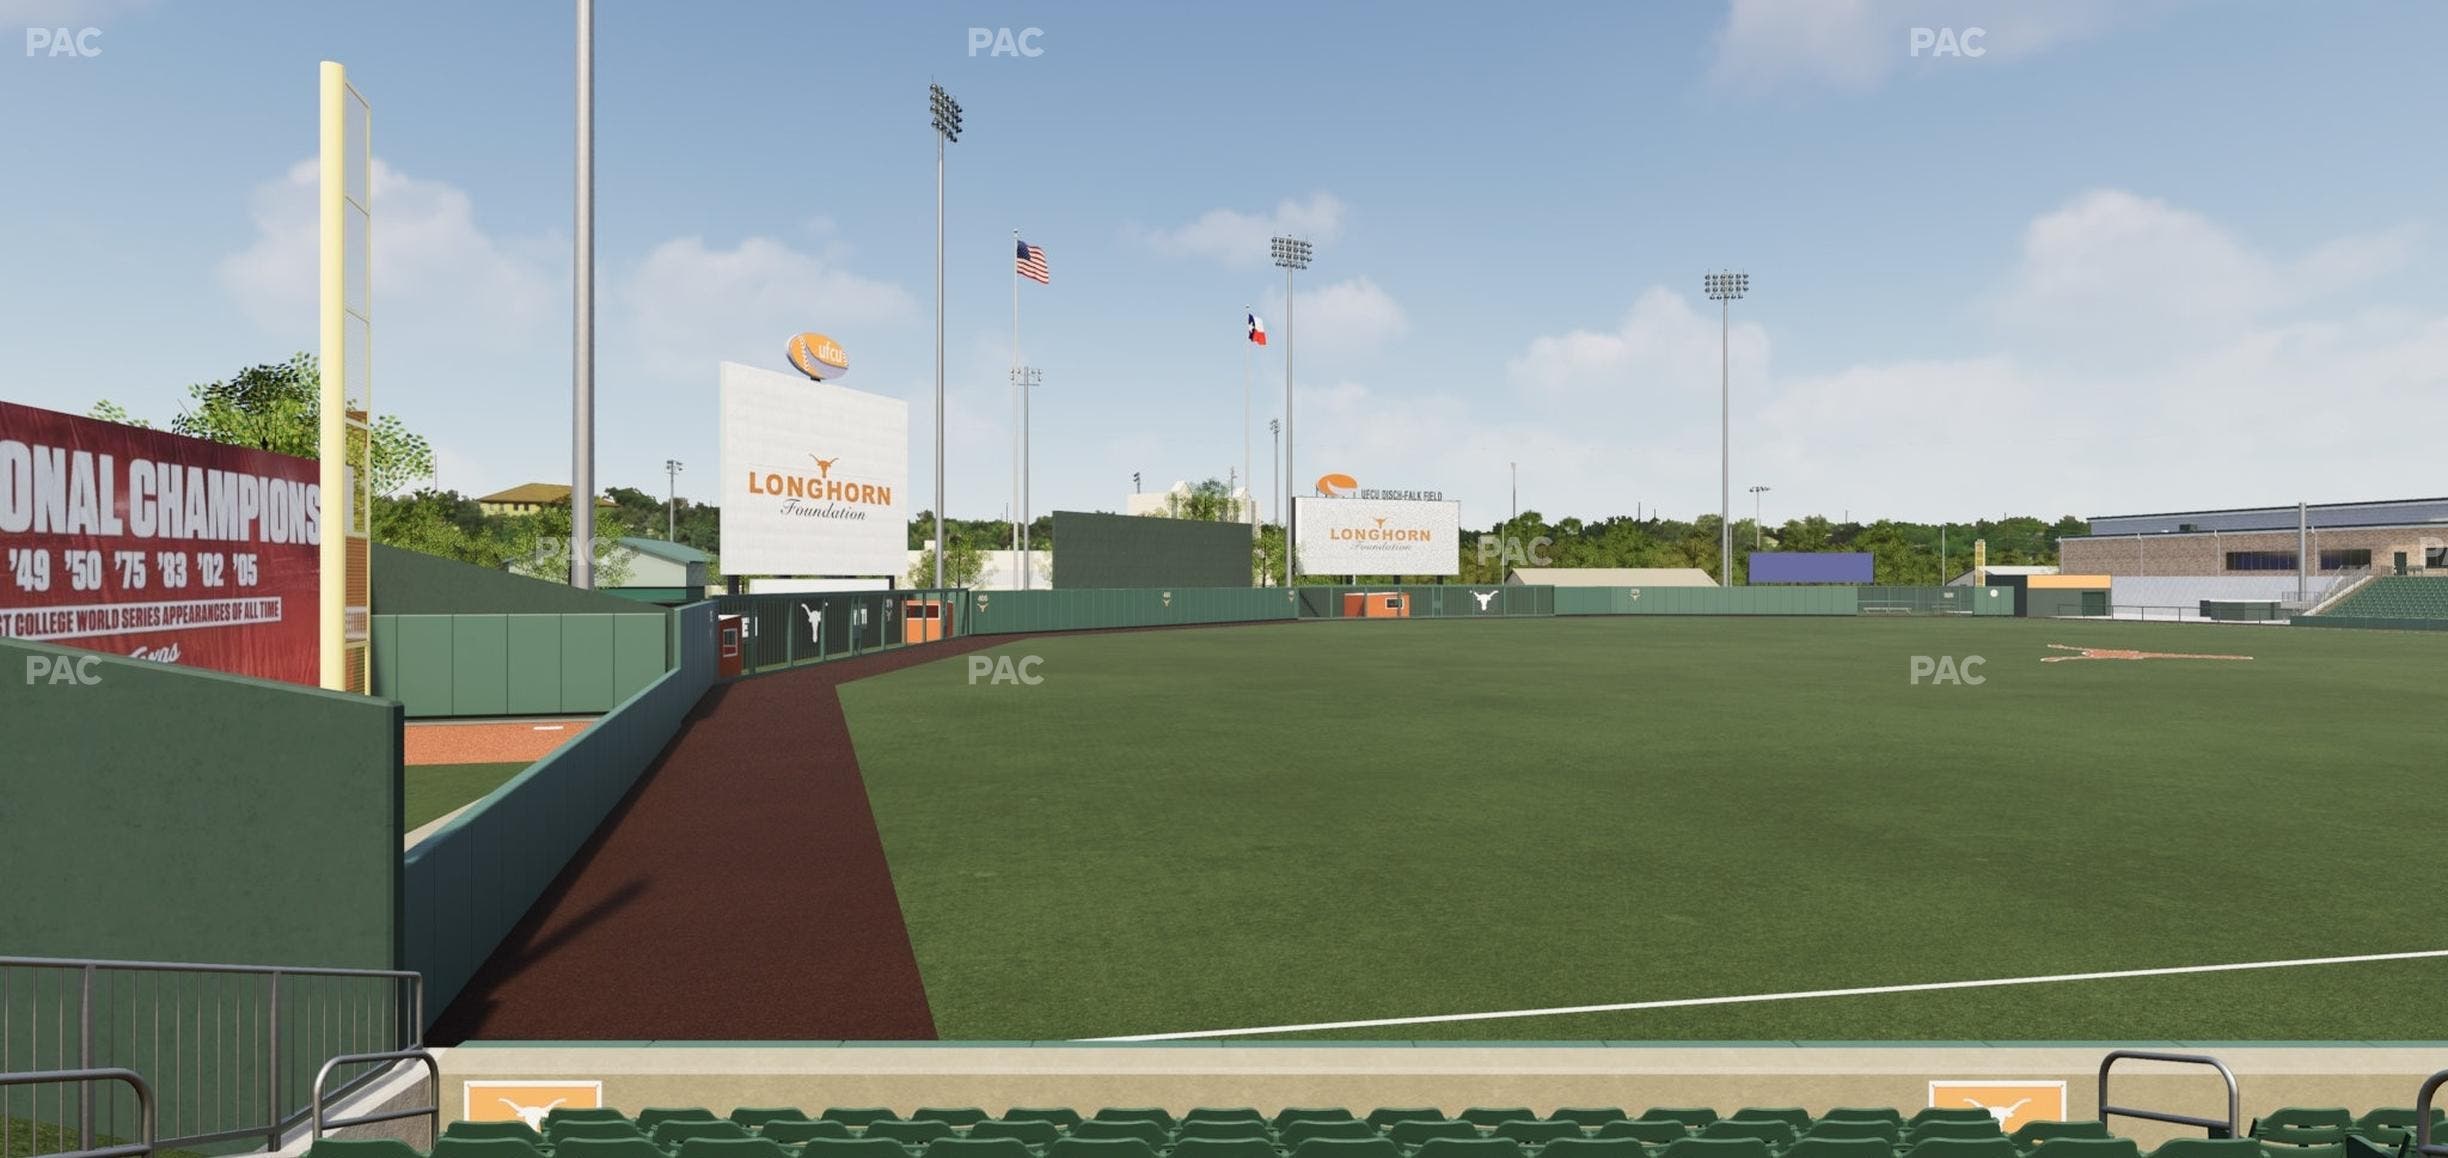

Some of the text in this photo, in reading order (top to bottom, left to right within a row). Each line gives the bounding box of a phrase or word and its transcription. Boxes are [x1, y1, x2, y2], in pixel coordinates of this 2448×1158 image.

[818, 341, 844, 364] ufcu
[0, 440, 320, 546] ONAL CHAMPIONS
[748, 471, 892, 506] LONGHORN
[1423, 490, 1443, 502] FIELD
[780, 498, 868, 521] Foundation
[1330, 527, 1432, 542] LONGHORN
[1350, 540, 1412, 552] Foundation
[8, 548, 258, 592] '49 '50 '75 '83 '02 '05
[15, 610, 74, 636] COLLEGE
[76, 607, 119, 632] WORLD
[121, 605, 161, 629] SERIES
[162, 602, 231, 626] APPEARANCES
[232, 602, 243, 619] OF
[244, 601, 259, 619] ALL
[260, 599, 280, 618] TIME
